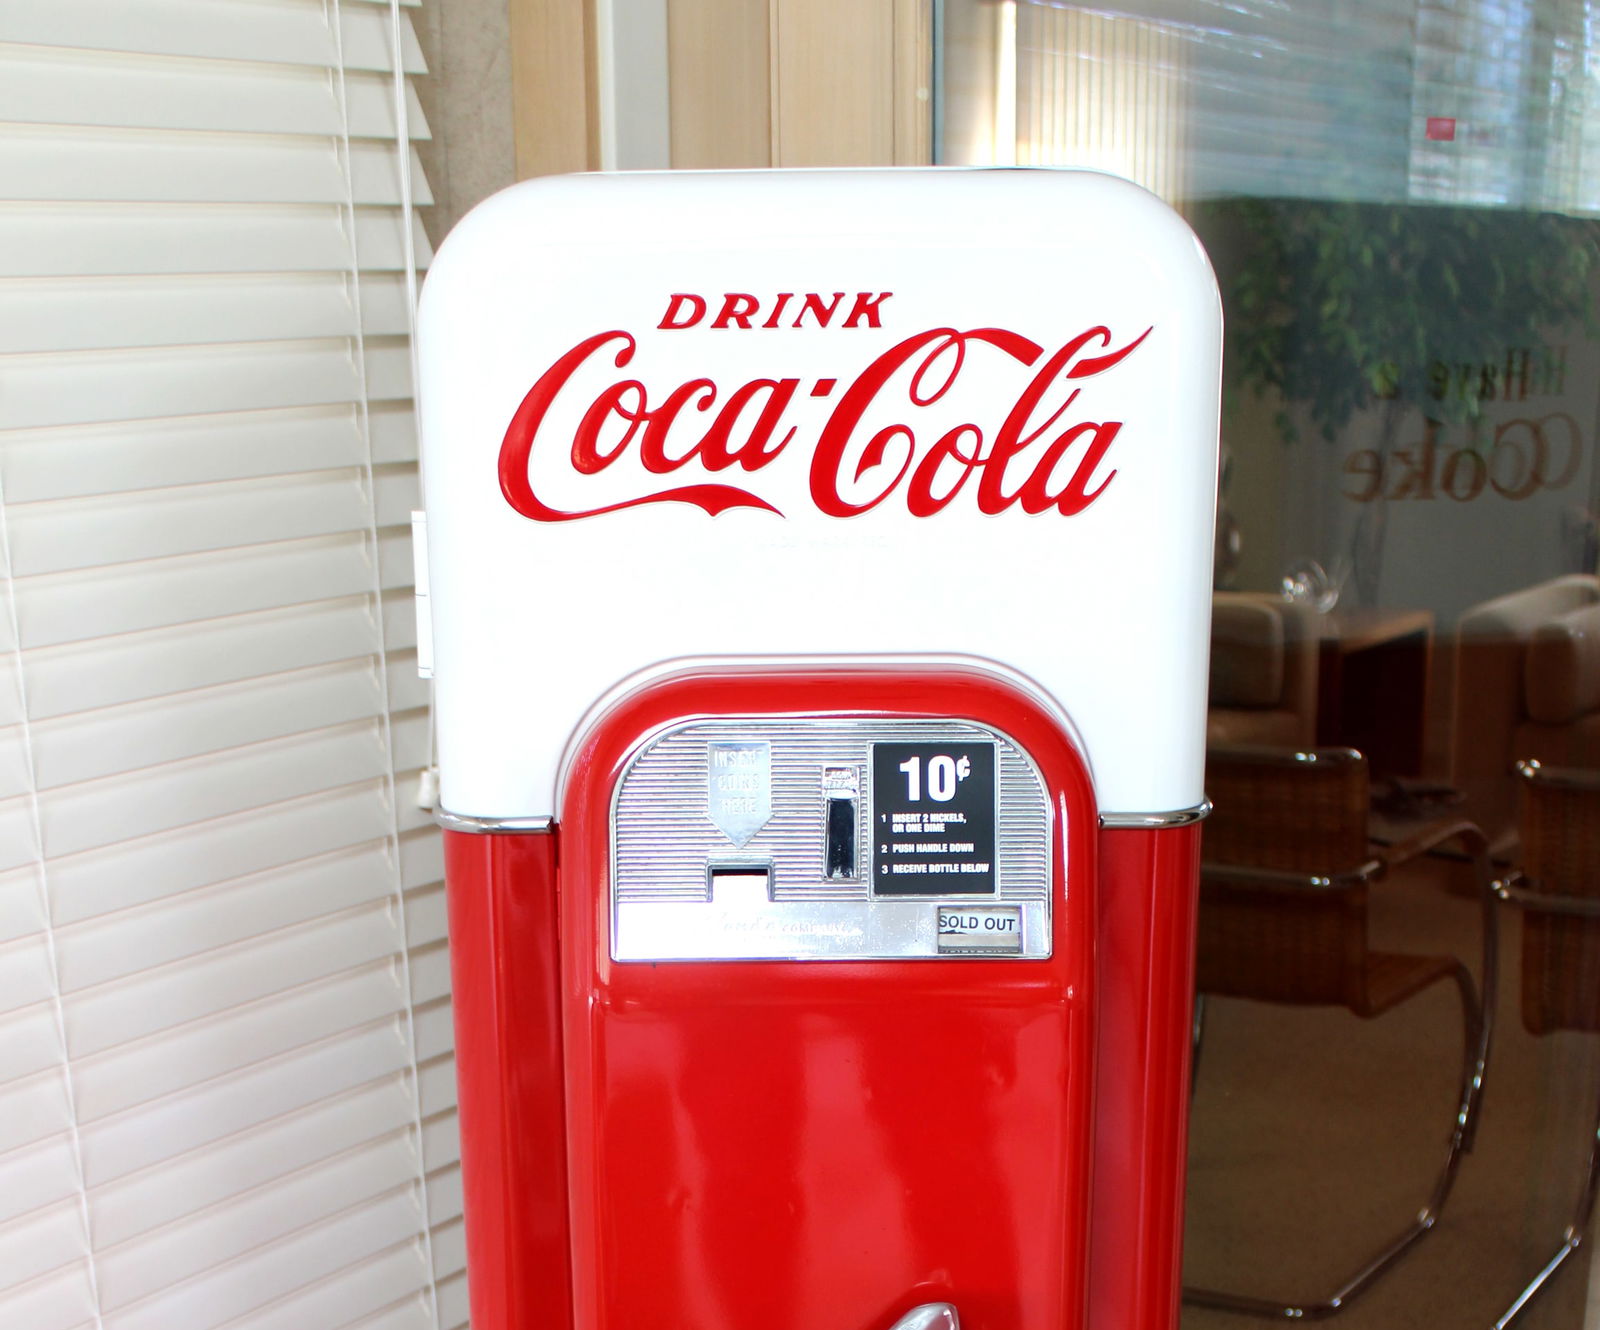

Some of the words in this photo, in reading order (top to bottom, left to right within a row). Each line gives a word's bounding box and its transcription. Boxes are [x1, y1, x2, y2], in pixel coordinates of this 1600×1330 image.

[657, 292, 893, 329] DRINK
[498, 325, 1153, 523] Coca-Cola
[881, 813, 887, 823] 1
[892, 813, 921, 823] INSERT
[922, 813, 929, 823] 2
[930, 813, 967, 824] NICKELS,
[892, 823, 905, 833] OR
[905, 823, 923, 833] ONE
[924, 823, 945, 833] DIME
[881, 844, 888, 854] 2
[892, 844, 915, 853] PUSH
[916, 844, 948, 853] HANDLE
[949, 843, 974, 853] DOWN
[881, 865, 889, 874] 3
[892, 864, 927, 874] RECEIVE
[928, 864, 960, 873] BOTTLE
[960, 864, 989, 873] BELOW
[938, 915, 979, 929] SOLD
[984, 917, 1016, 931] OUT
